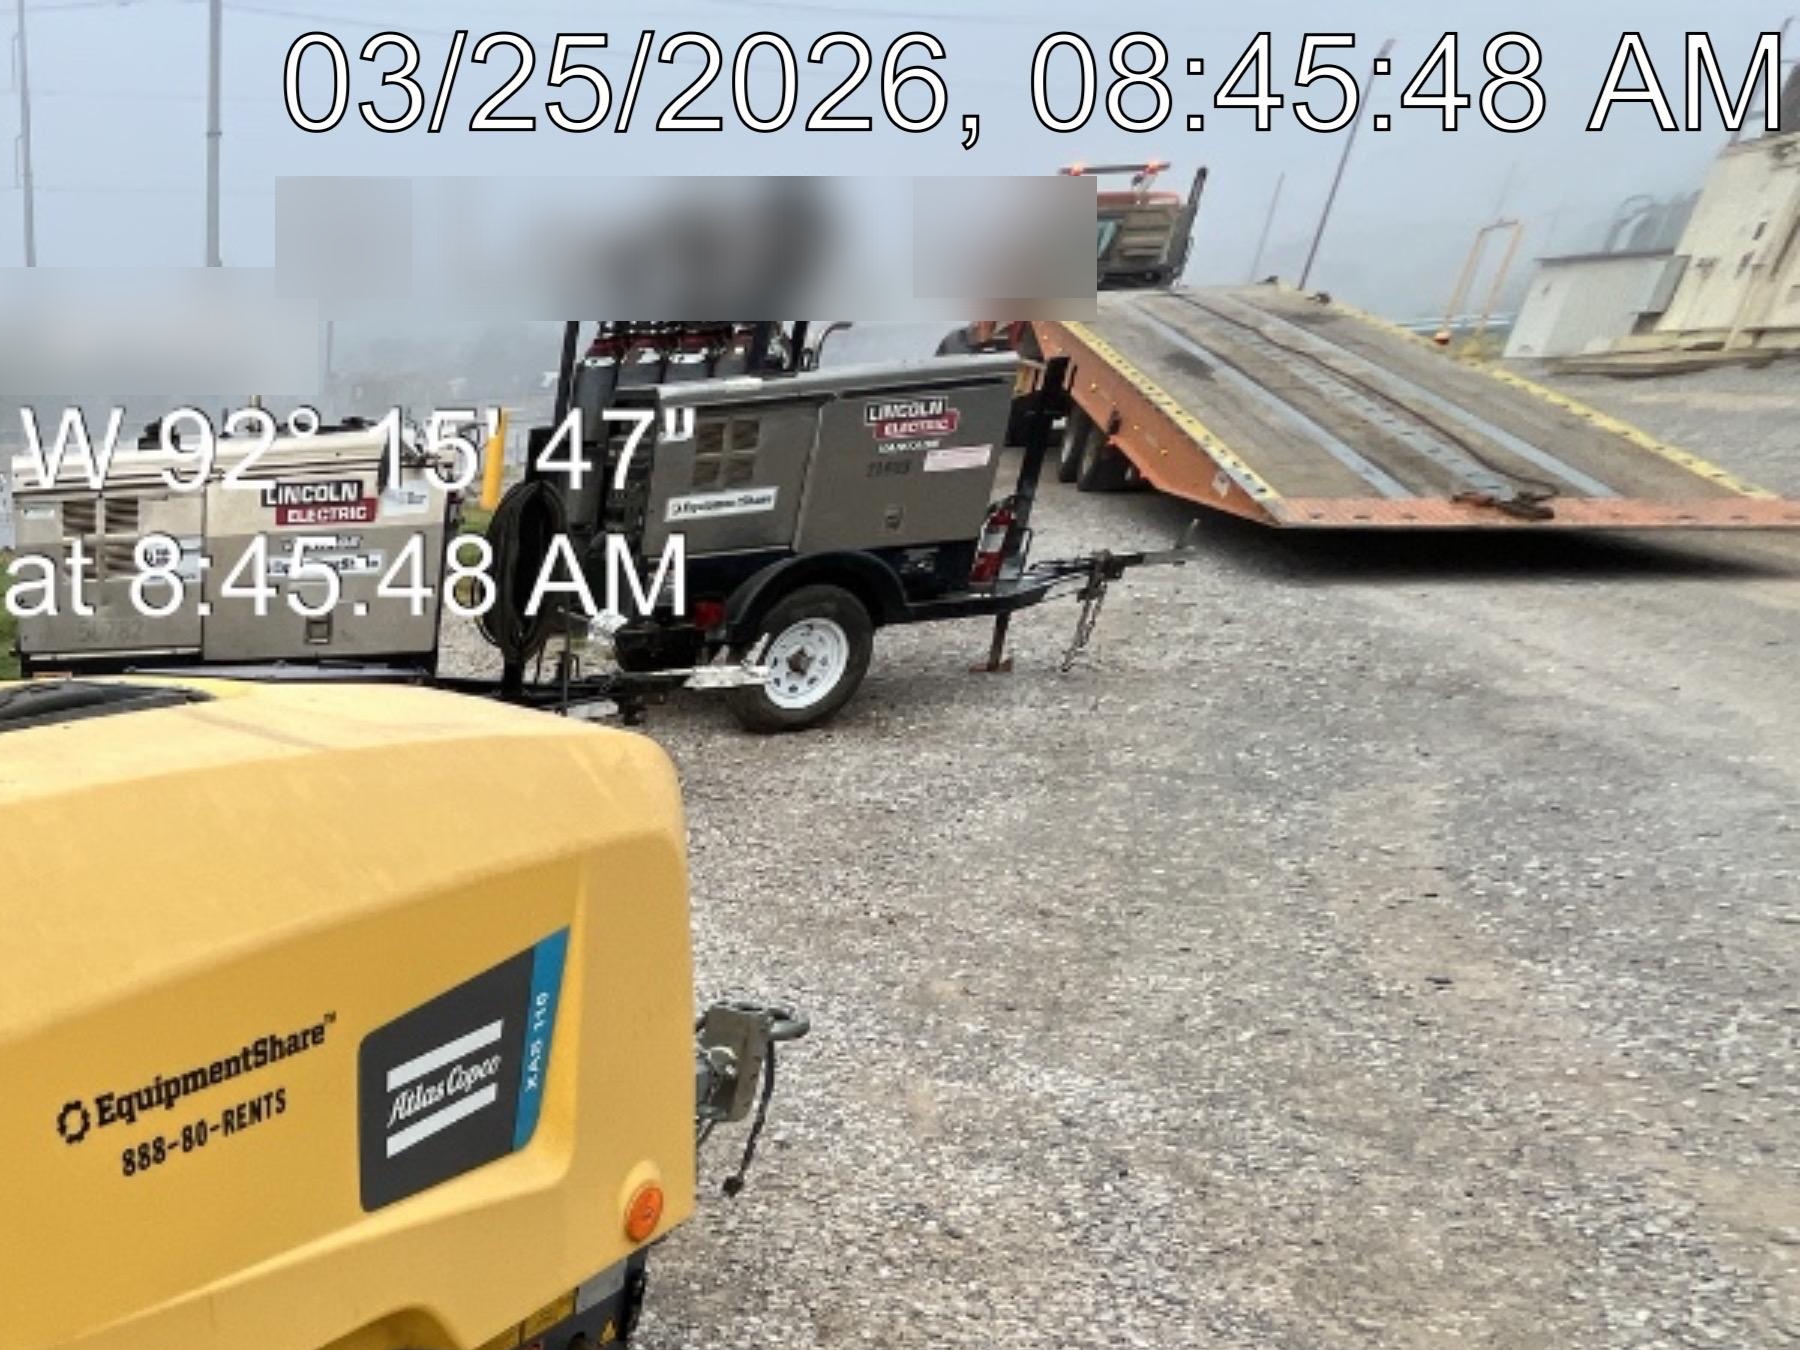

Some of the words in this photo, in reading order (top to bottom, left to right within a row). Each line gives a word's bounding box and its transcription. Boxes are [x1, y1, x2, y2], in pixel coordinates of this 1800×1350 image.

[869, 400, 943, 421] LINCOLN
[266, 482, 358, 505] LINCOLN
[287, 506, 367, 523] ELECTRIC
[534, 992, 550, 1032] 110
[526, 1040, 544, 1092] XAS
[387, 1081, 445, 1129] Atlas
[446, 1055, 502, 1097] Copco
[121, 1088, 287, 1177] 888-80-RENTS
